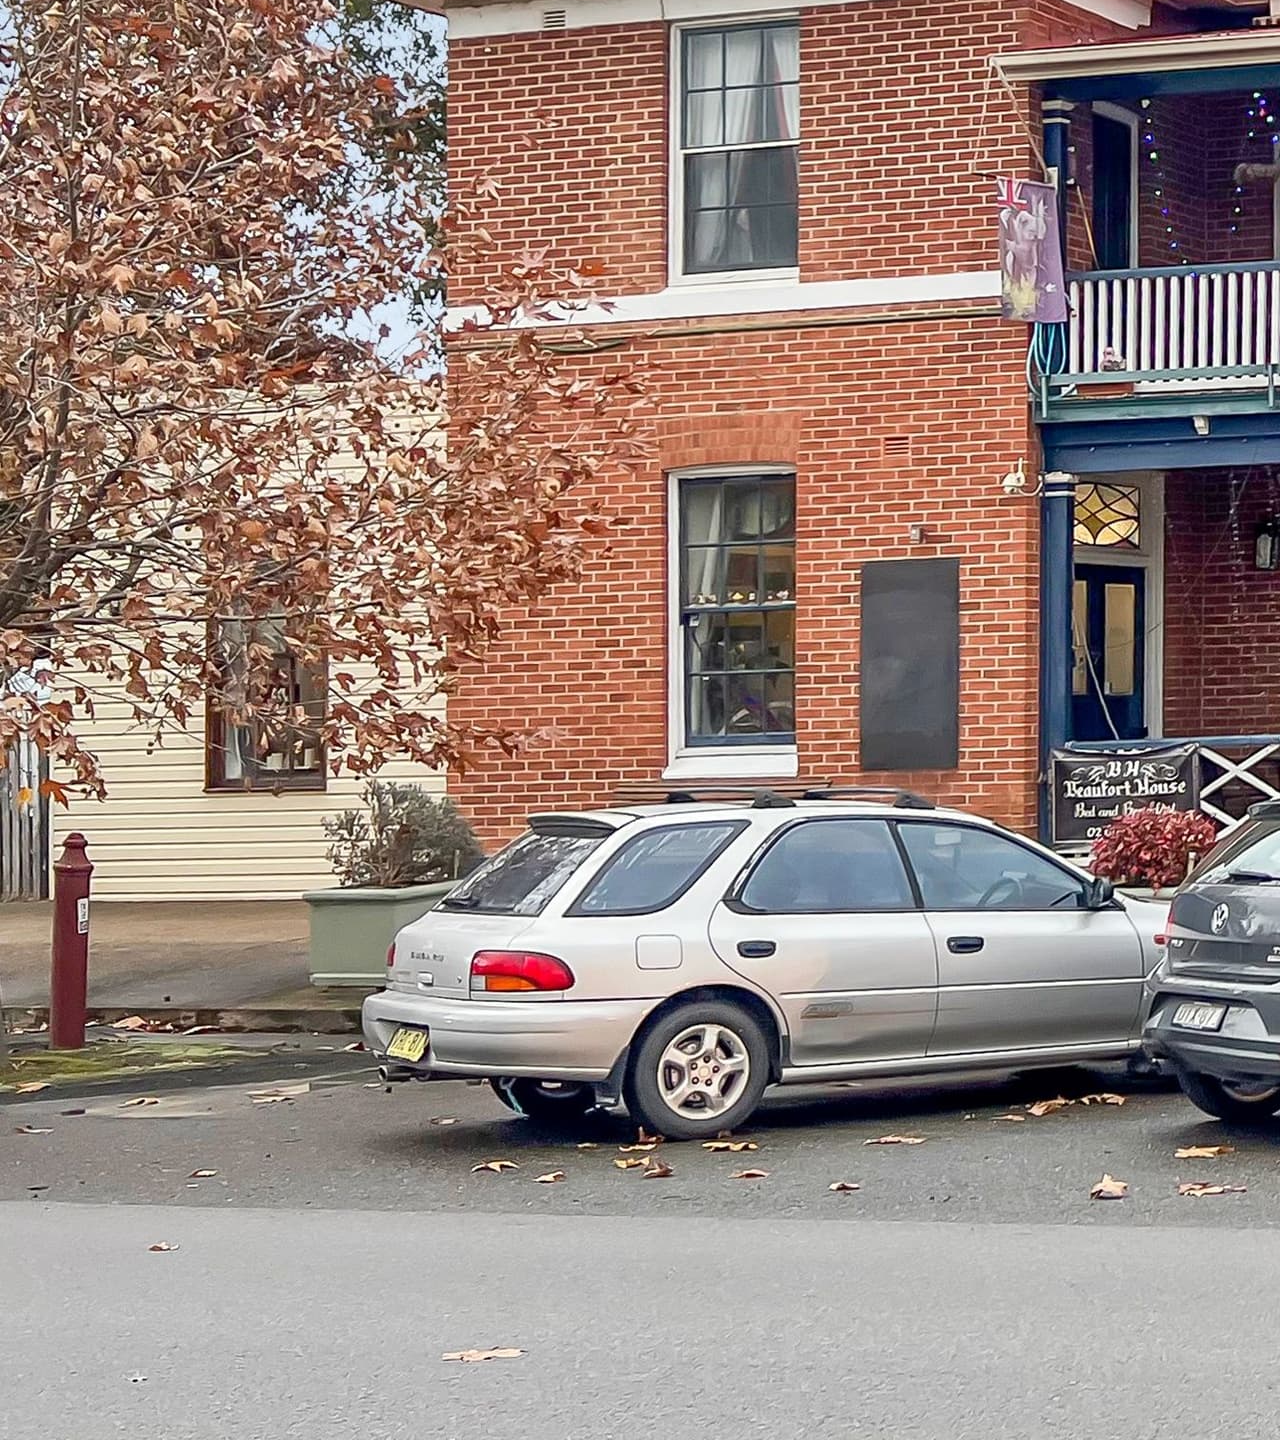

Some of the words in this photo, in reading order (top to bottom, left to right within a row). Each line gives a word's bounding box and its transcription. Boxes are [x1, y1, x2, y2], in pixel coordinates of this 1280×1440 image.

[1063, 780, 1131, 798] Beaufort
[1133, 778, 1187, 796] House
[1074, 801, 1096, 818] Bed
[1098, 804, 1120, 817] and
